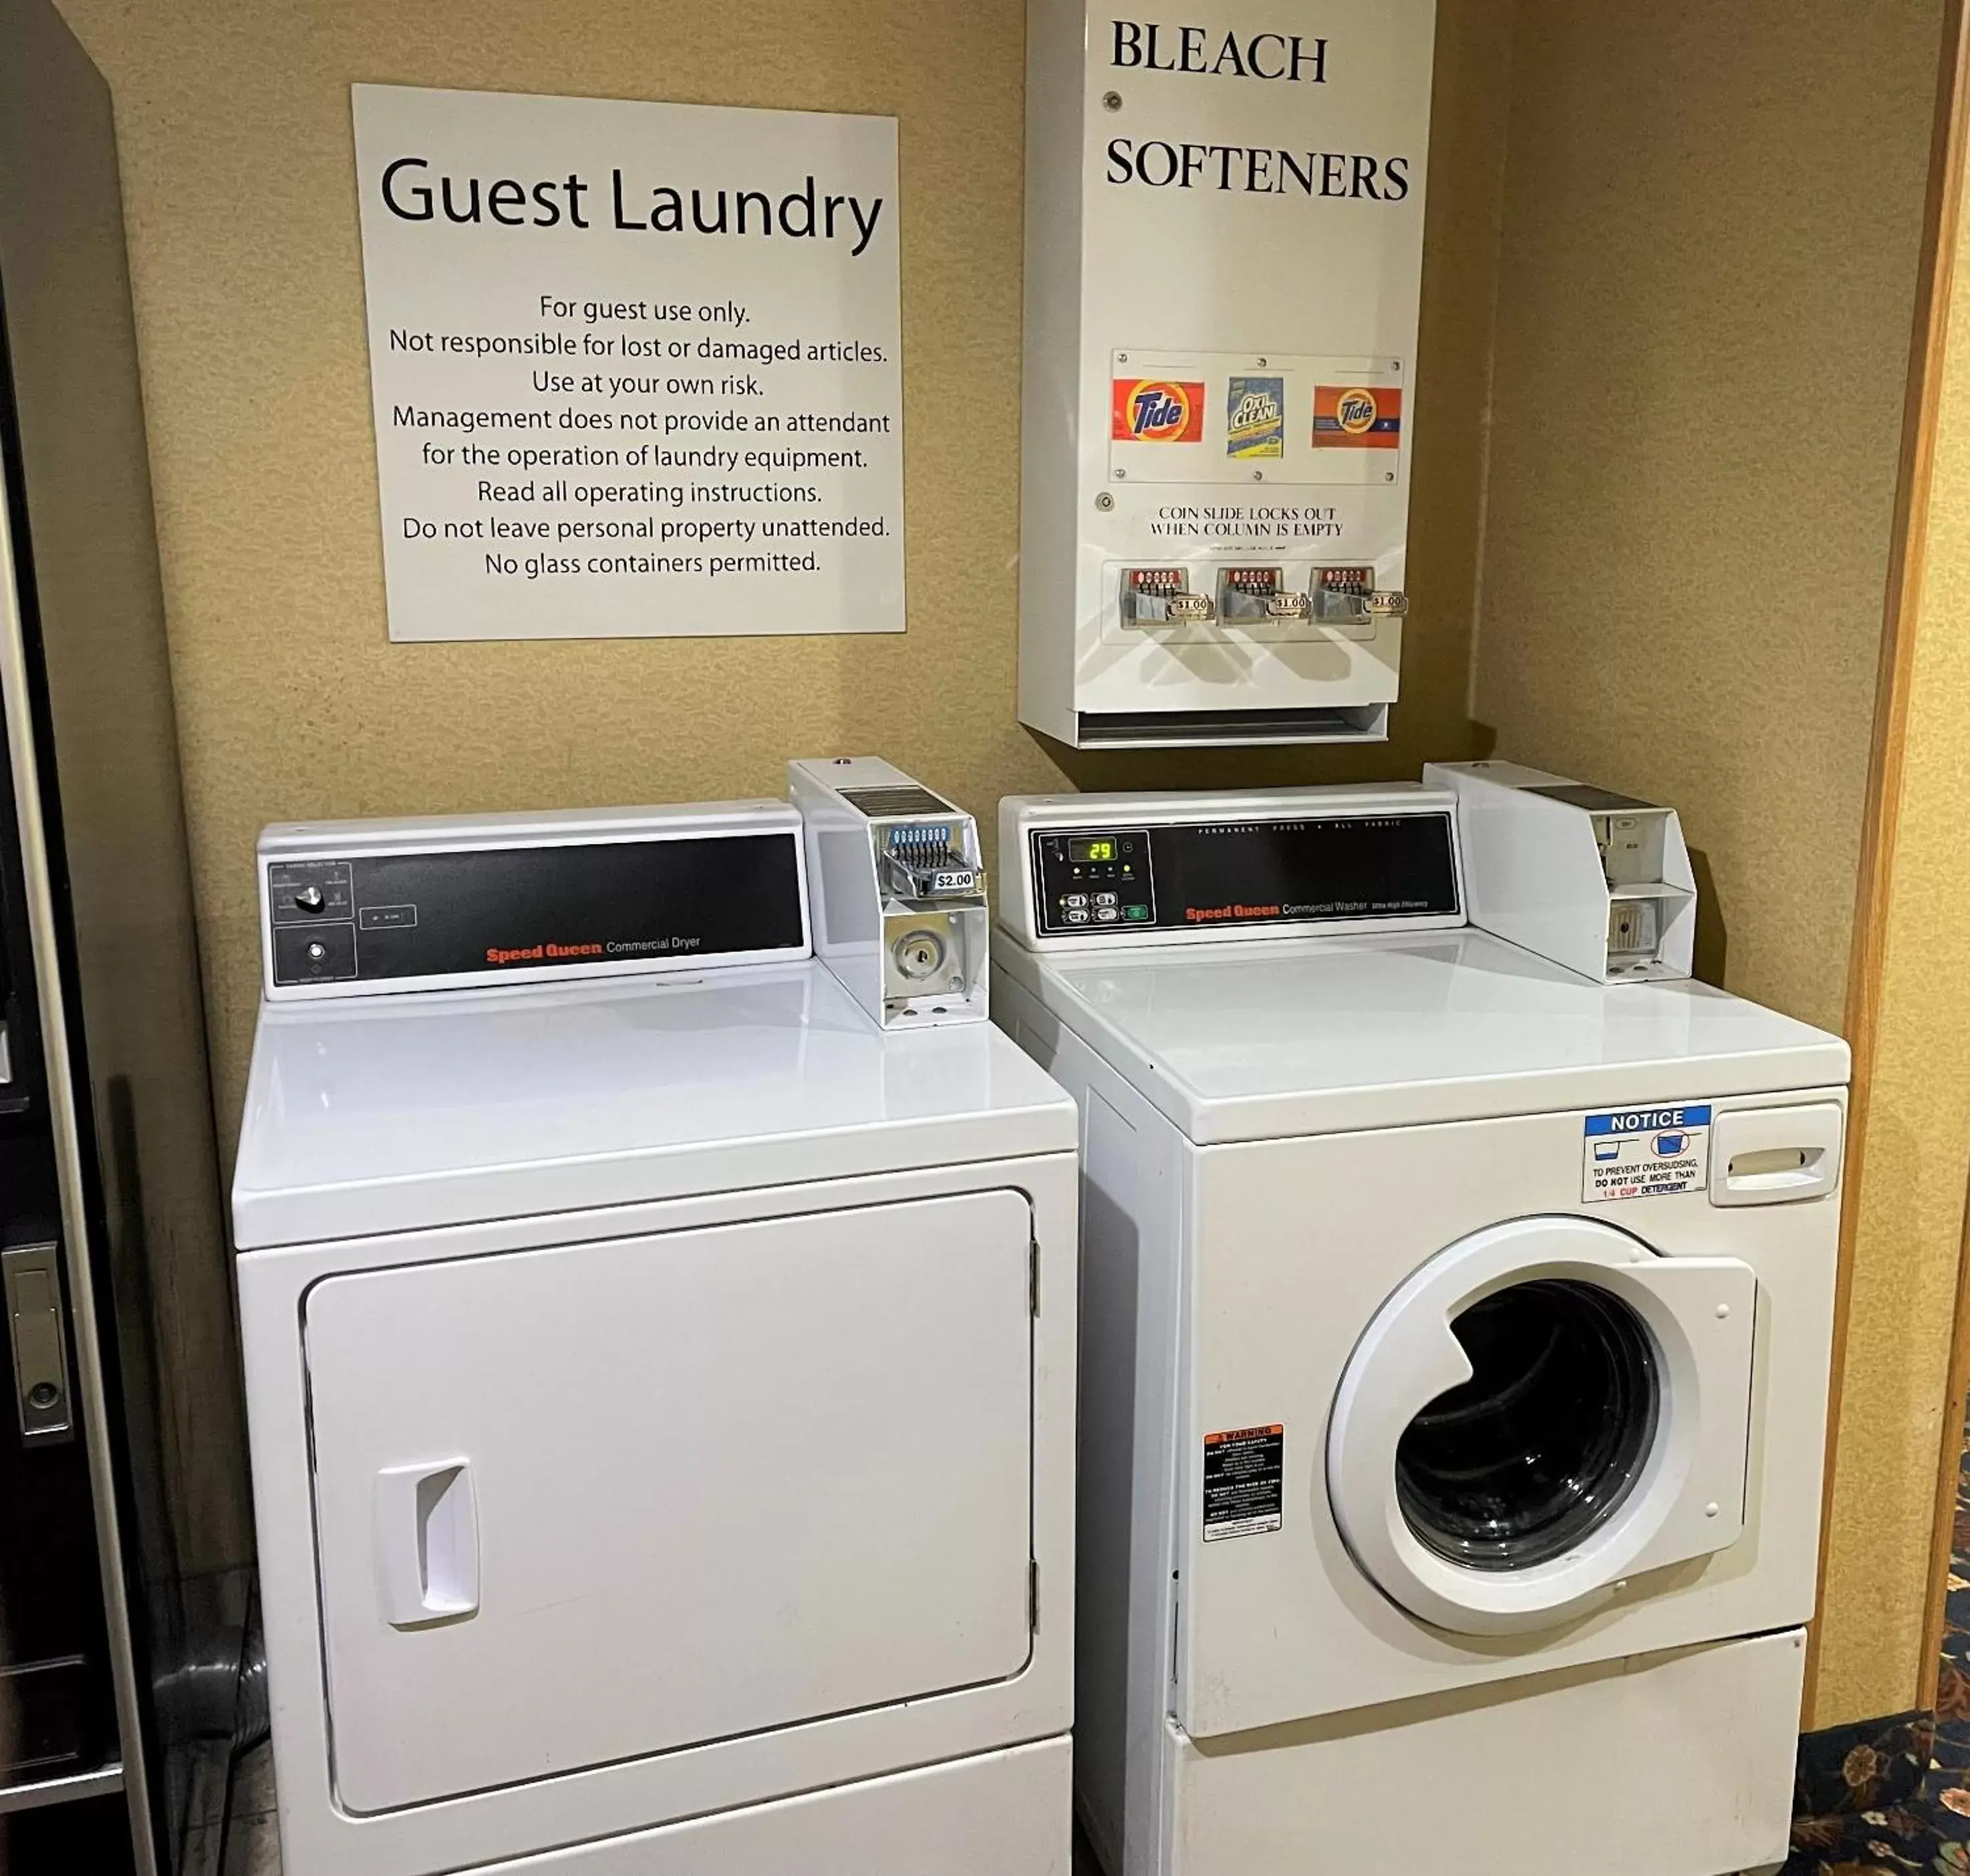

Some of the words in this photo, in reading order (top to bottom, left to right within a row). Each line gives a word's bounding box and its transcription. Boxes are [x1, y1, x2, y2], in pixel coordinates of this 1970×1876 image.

[1110, 20, 1328, 84] BLEACH
[1107, 138, 1409, 201] SOFTENERS
[382, 158, 589, 229] Guest
[612, 168, 883, 257] Laundry
[541, 295, 577, 317] For
[583, 301, 648, 324] guest
[654, 304, 692, 321] use
[698, 300, 750, 328] only.
[390, 329, 434, 352] Not
[440, 331, 577, 358] responsible
[583, 333, 615, 356] for
[621, 333, 662, 357] lost
[668, 341, 692, 358] or
[697, 336, 801, 365] damaged
[807, 340, 887, 362] articles.
[533, 370, 575, 392] Use
[581, 373, 603, 394] at
[608, 377, 660, 399] your
[666, 378, 714, 395] own
[721, 373, 764, 396] risk.
[1134, 392, 1182, 434] Tide
[1244, 396, 1268, 413] OXI
[1342, 400, 1373, 424] Tide
[394, 405, 553, 434] Management
[559, 406, 613, 430] does
[620, 412, 658, 430] not
[665, 409, 748, 436] provide
[754, 416, 780, 432] an
[786, 411, 890, 433] attendant
[1234, 405, 1274, 428] CLEAN
[422, 442, 455, 464] for
[461, 443, 501, 466] the
[507, 444, 619, 471] operation
[625, 444, 650, 466] of
[654, 444, 739, 472] laundry
[744, 447, 867, 472] equipment.
[478, 480, 535, 502] Read
[543, 480, 567, 502] all
[574, 481, 684, 508] operating
[690, 481, 822, 502] instructions.
[1159, 506, 1199, 520] COIN
[1204, 507, 1244, 520] SLIDE
[1250, 507, 1298, 520] LOCKS
[1304, 507, 1336, 520] OUT
[403, 518, 437, 539] Do
[444, 520, 484, 538] not
[490, 516, 550, 538] leave
[557, 516, 654, 543] personal
[661, 519, 756, 543] property
[762, 516, 890, 537] unattended.
[1151, 523, 1199, 536] WHEN
[1204, 522, 1271, 536] COLUMN
[1276, 523, 1288, 536] IS
[1294, 523, 1343, 536] EMPTY
[485, 553, 519, 575] No
[525, 552, 581, 580] glass
[587, 553, 703, 573] containers
[710, 550, 821, 577] permitted.
[1177, 598, 1207, 611] $1.00
[1276, 597, 1306, 609] $1.00
[1373, 595, 1402, 607] $1.00
[1090, 843, 1111, 860] 29
[938, 873, 972, 887] $2.00
[1185, 907, 1231, 920] Speed
[1234, 905, 1280, 917] Queen
[1283, 903, 1333, 914] Commercial
[1336, 902, 1367, 910] Washer
[486, 946, 543, 963] Speed
[545, 945, 601, 957] Queen
[607, 939, 669, 953] Commercial
[672, 937, 700, 949] Dryer
[1611, 1110, 1684, 1130] NOTICE
[1593, 1168, 1604, 1177] TO
[1605, 1165, 1641, 1176] PREVENT
[1611, 1178, 1628, 1186] NOT
[1631, 1175, 1645, 1184] USE
[1649, 1172, 1672, 1182] MORE
[1675, 1170, 1696, 1179] THAN
[1620, 1187, 1637, 1195] CUP
[1641, 1182, 1687, 1194] DETERGENT
